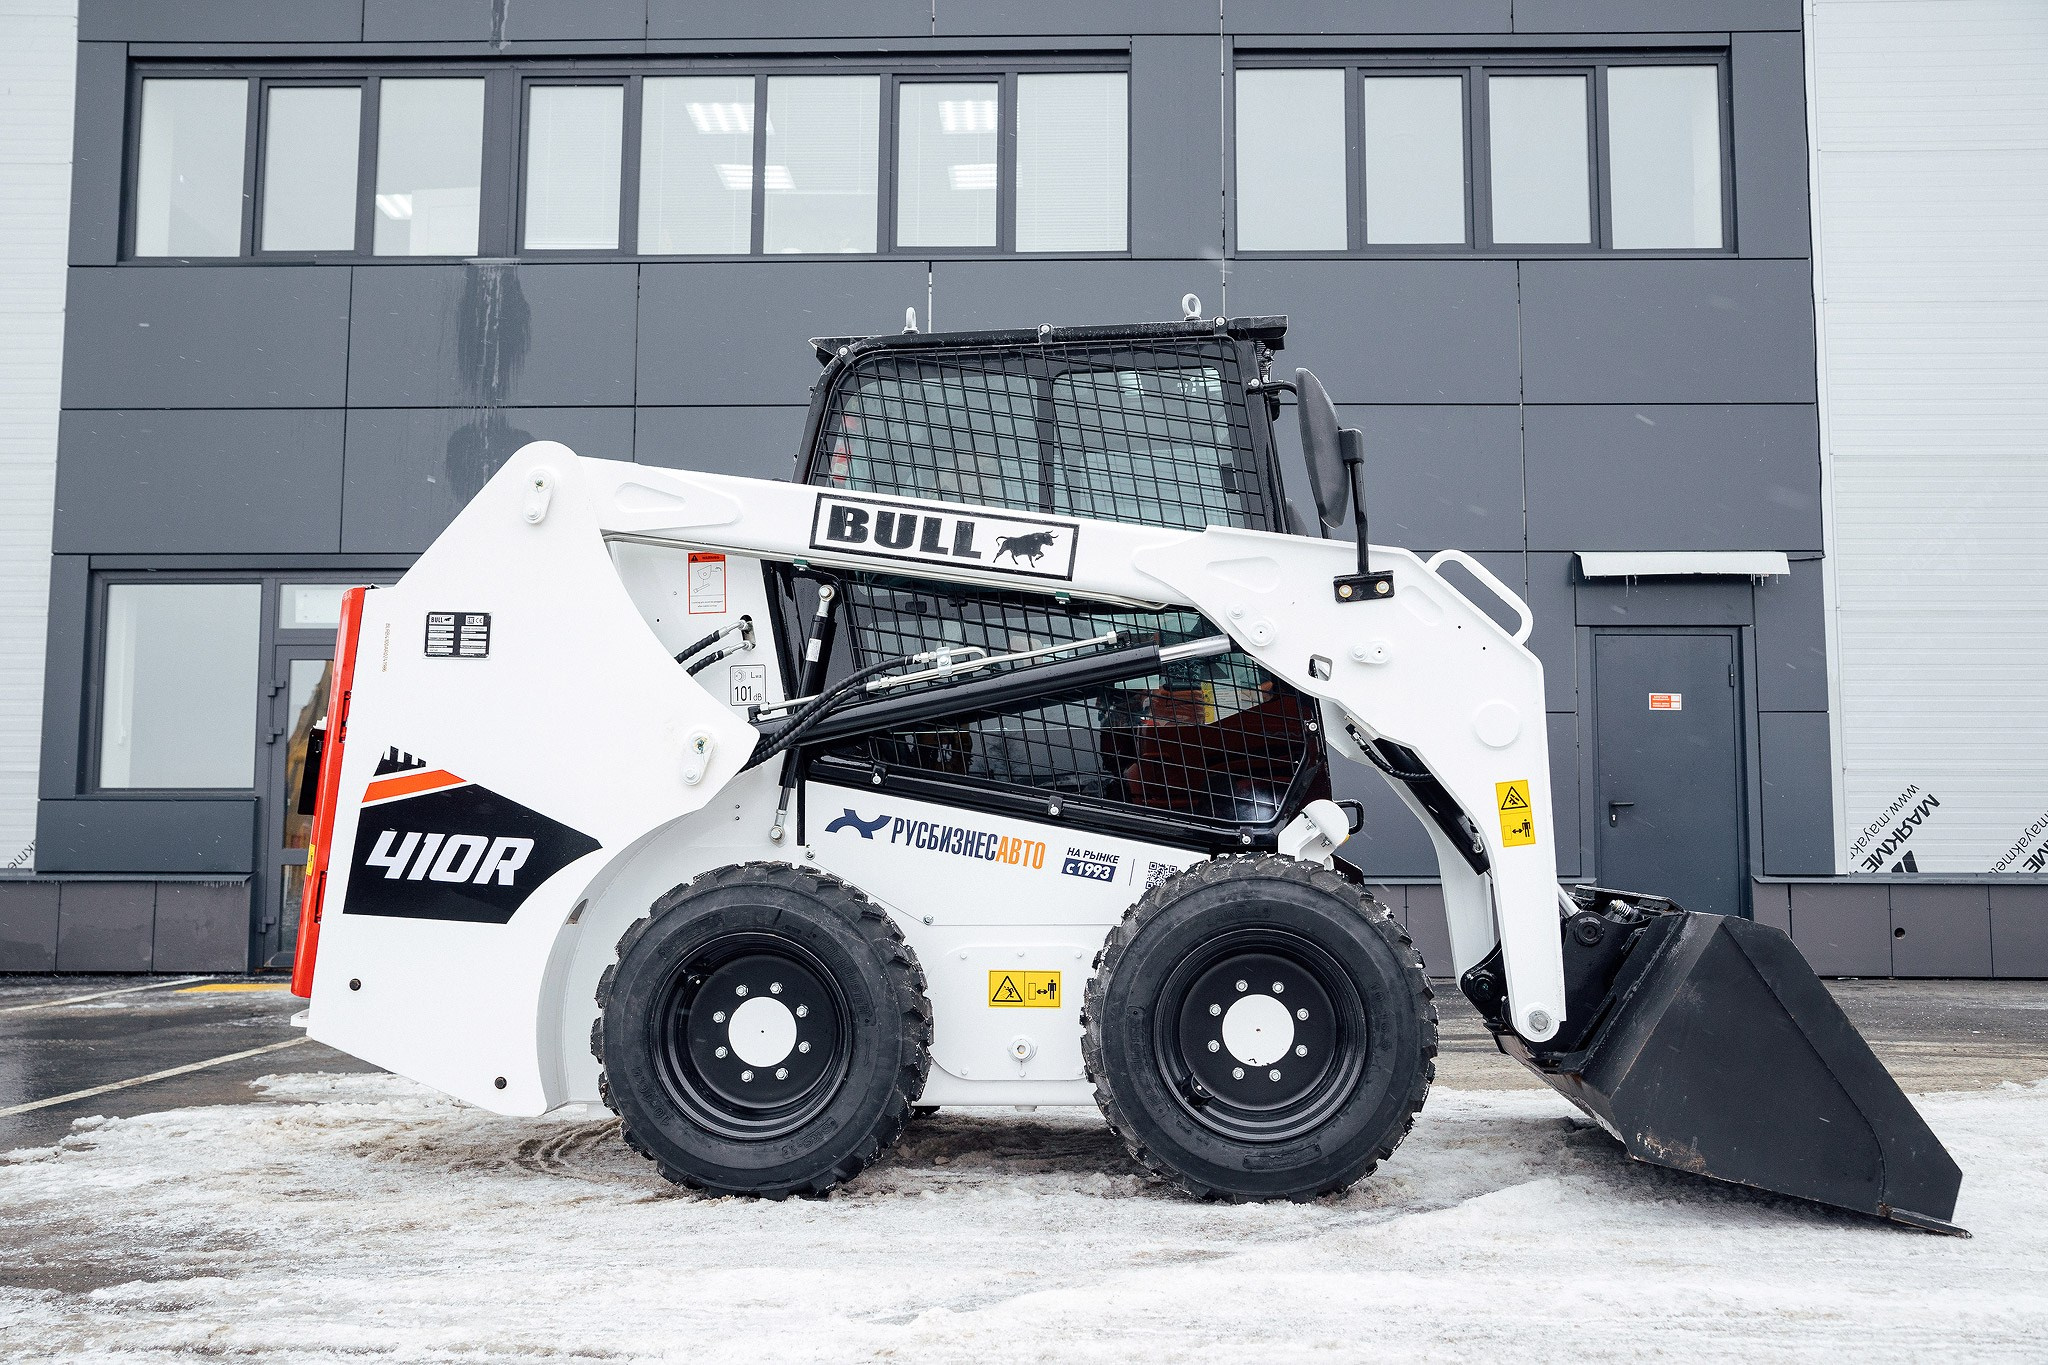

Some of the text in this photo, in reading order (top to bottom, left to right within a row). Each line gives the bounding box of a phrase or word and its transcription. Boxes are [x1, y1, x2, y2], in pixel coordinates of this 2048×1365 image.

[826, 504, 982, 560] BULL
[735, 686, 763, 702] 101 dB
[365, 830, 535, 886] 410R
[891, 817, 1046, 870] РУСБИЗНЕСАВТО
[1067, 847, 1120, 864] НА РЫНКЕ
[1850, 793, 1941, 873] МАЯКМЕ
[1077, 862, 1111, 880] 1993
